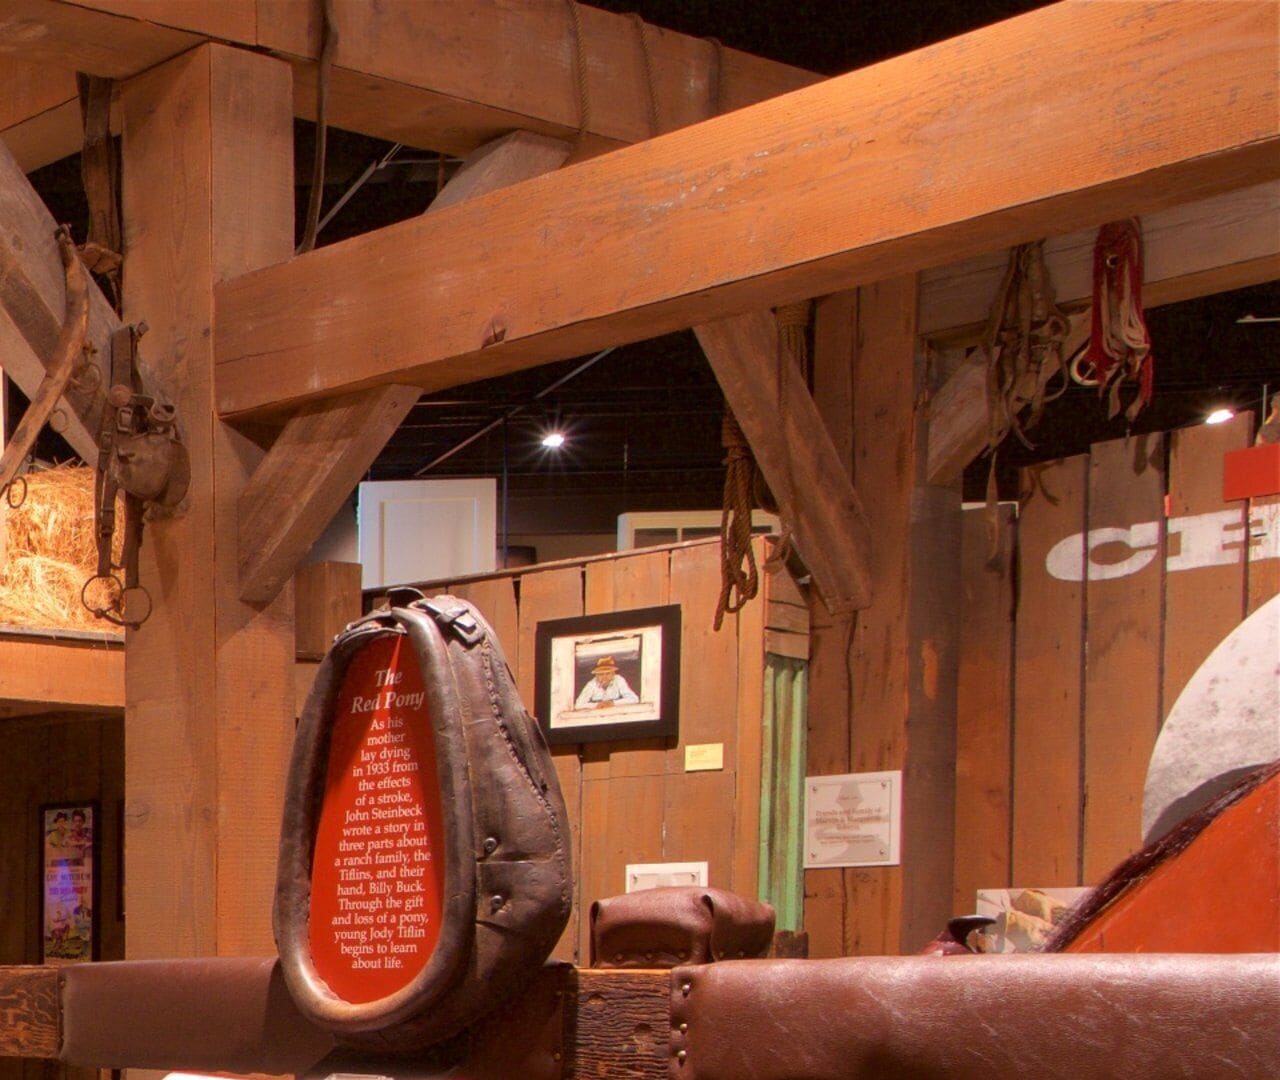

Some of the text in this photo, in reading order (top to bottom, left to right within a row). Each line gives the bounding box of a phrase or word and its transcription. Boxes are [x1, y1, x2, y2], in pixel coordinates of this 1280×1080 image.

[375, 668, 402, 687] The
[351, 692, 424, 714] Red Pony
[370, 719, 385, 731] As
[367, 732, 406, 746] mother
[361, 747, 411, 764] lay dying
[353, 760, 419, 778] in 1933 from
[359, 777, 413, 791] the effects
[356, 791, 413, 806] of stroke,
[345, 804, 423, 824] John Steinbeck
[343, 820, 425, 837] wrote story in
[339, 835, 428, 853] three parts about
[344, 850, 432, 865] ranch family, the
[377, 867, 396, 879] and
[401, 865, 425, 878] their
[337, 881, 426, 897] hand, Billy Buck.
[338, 896, 424, 912] Through the gift
[332, 912, 428, 926] and loss of pony,
[335, 931, 367, 944] young
[370, 927, 394, 942] Jody
[341, 942, 418, 958] begins to learn
[352, 957, 404, 969] about life.
